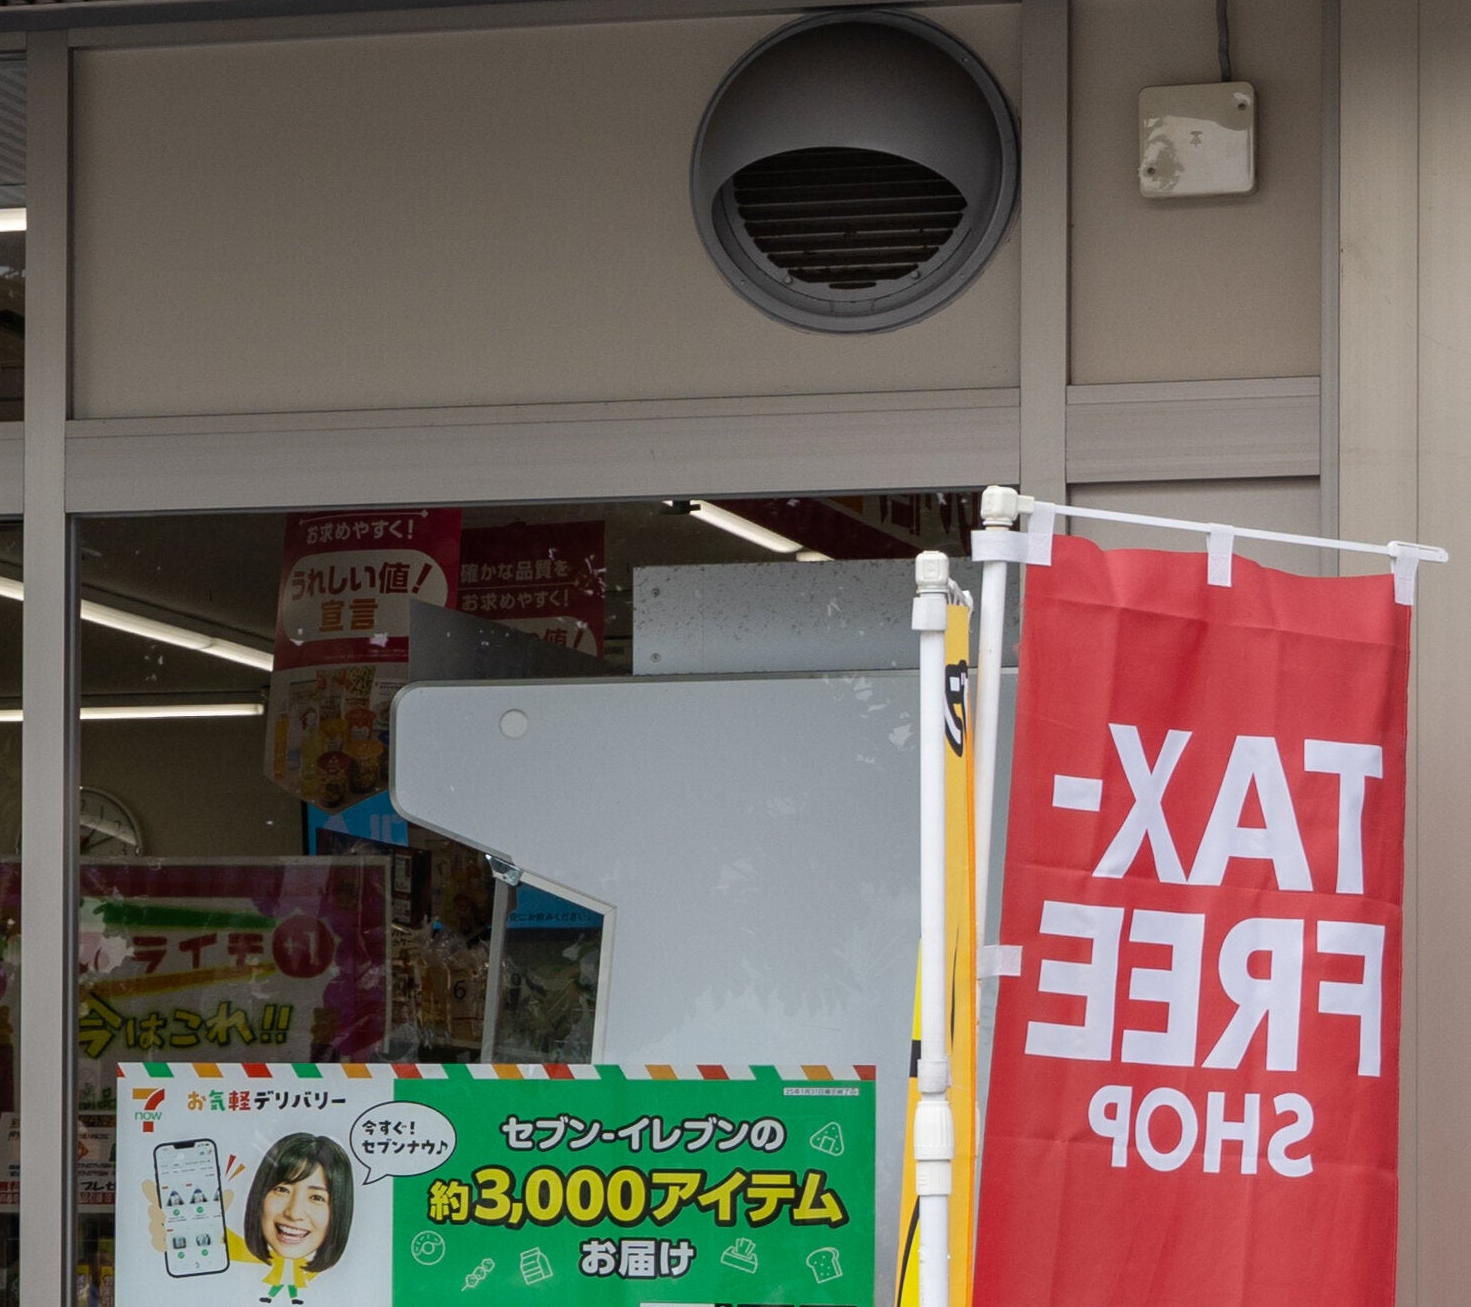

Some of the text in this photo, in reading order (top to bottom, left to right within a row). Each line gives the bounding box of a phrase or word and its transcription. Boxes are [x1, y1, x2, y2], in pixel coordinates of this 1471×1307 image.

[305, 519, 415, 544] お求めやすく!
[289, 561, 433, 602] うれしい値!
[460, 559, 570, 584] 確かな品質を
[461, 588, 571, 612] お求めやすく!
[318, 597, 380, 633] 宣言
[187, 1089, 347, 1112] お気軽デリバリー
[134, 1111, 162, 1121] now
[361, 1119, 416, 1136] 今すぐ!
[501, 1115, 785, 1152] セブン-イレブンの
[427, 1165, 846, 1231] 約3,000アイテム
[581, 1236, 694, 1278] お届け
